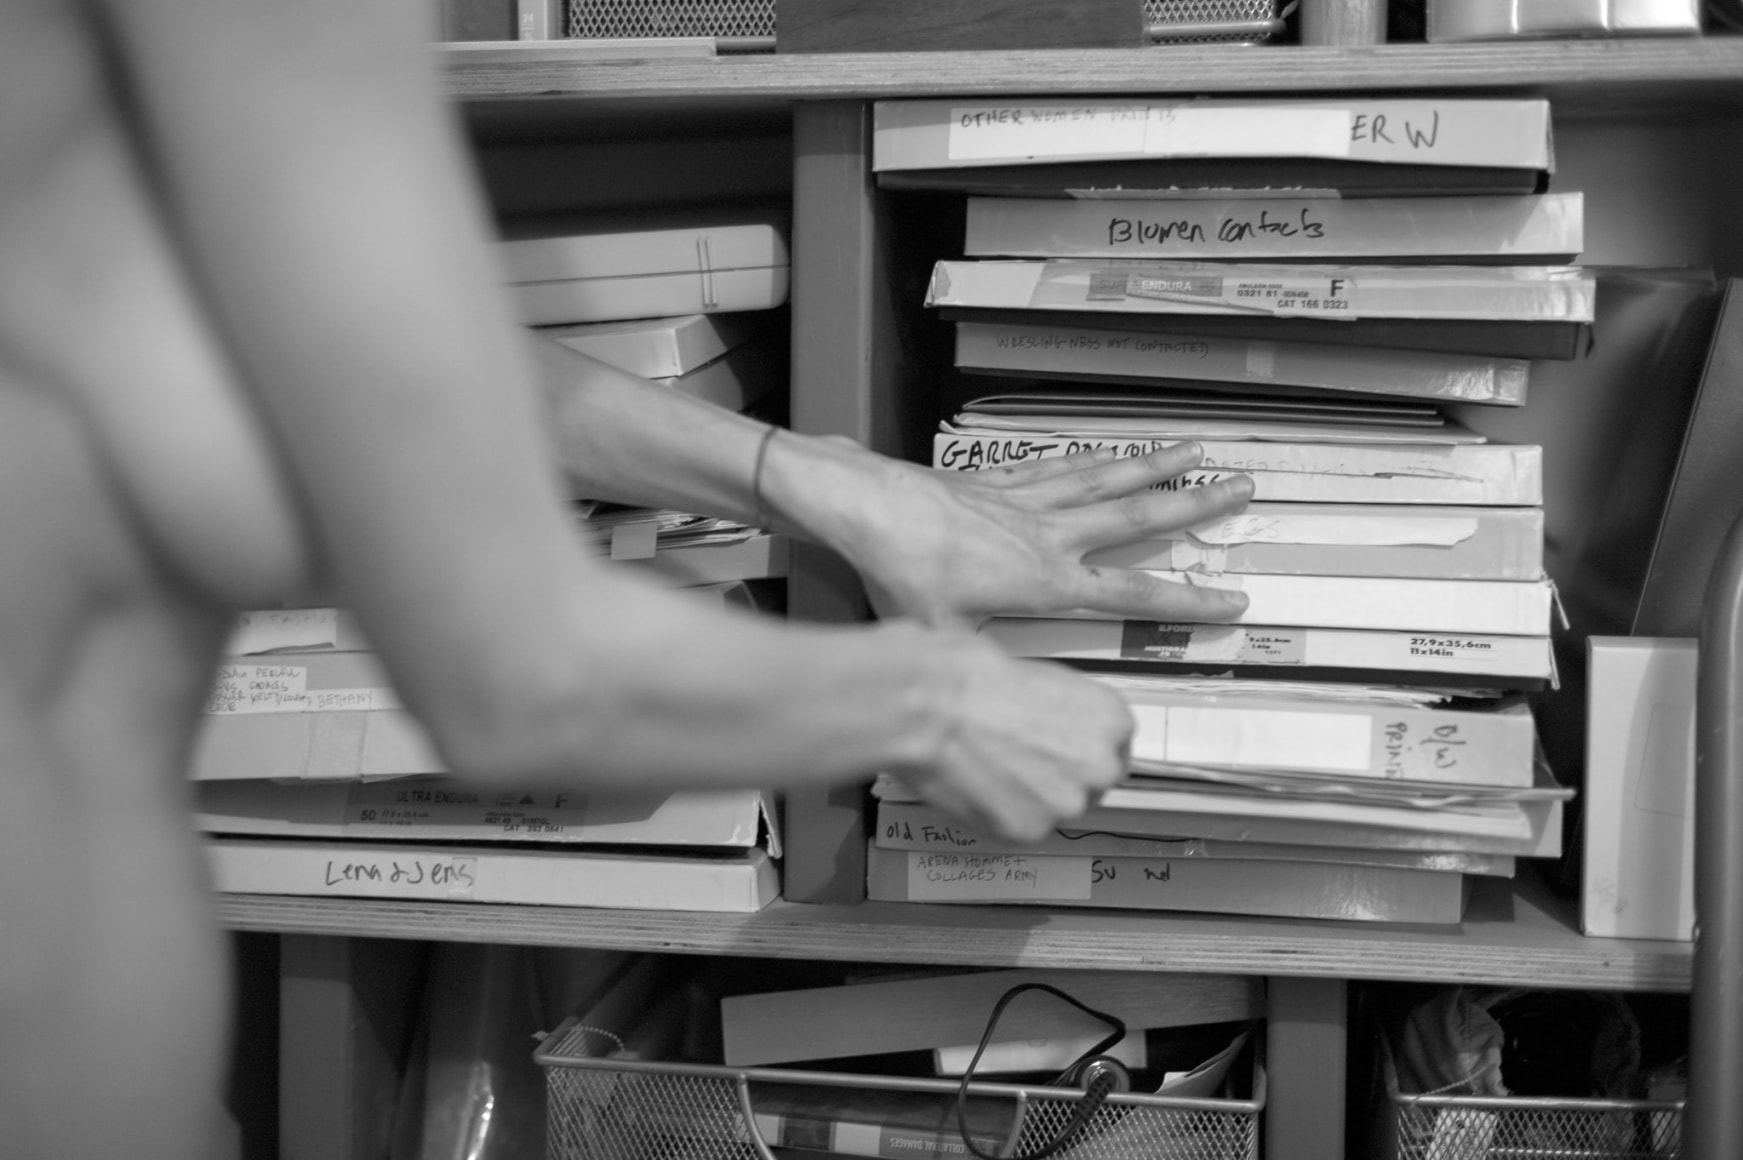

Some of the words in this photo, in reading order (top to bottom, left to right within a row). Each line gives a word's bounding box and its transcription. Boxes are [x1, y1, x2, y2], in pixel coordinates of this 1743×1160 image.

[961, 108, 1023, 128] OTHER
[1108, 218, 1205, 246] Blumen
[1141, 280, 1192, 293] ENDURA
[1329, 279, 1344, 298] F
[1277, 300, 1295, 308] CAT
[396, 790, 431, 803] ULTRA
[433, 791, 479, 804] ENDURA
[360, 809, 376, 821] 50
[886, 821, 914, 841] Old
[917, 855, 959, 868] ARENA
[325, 861, 382, 886] Lena
